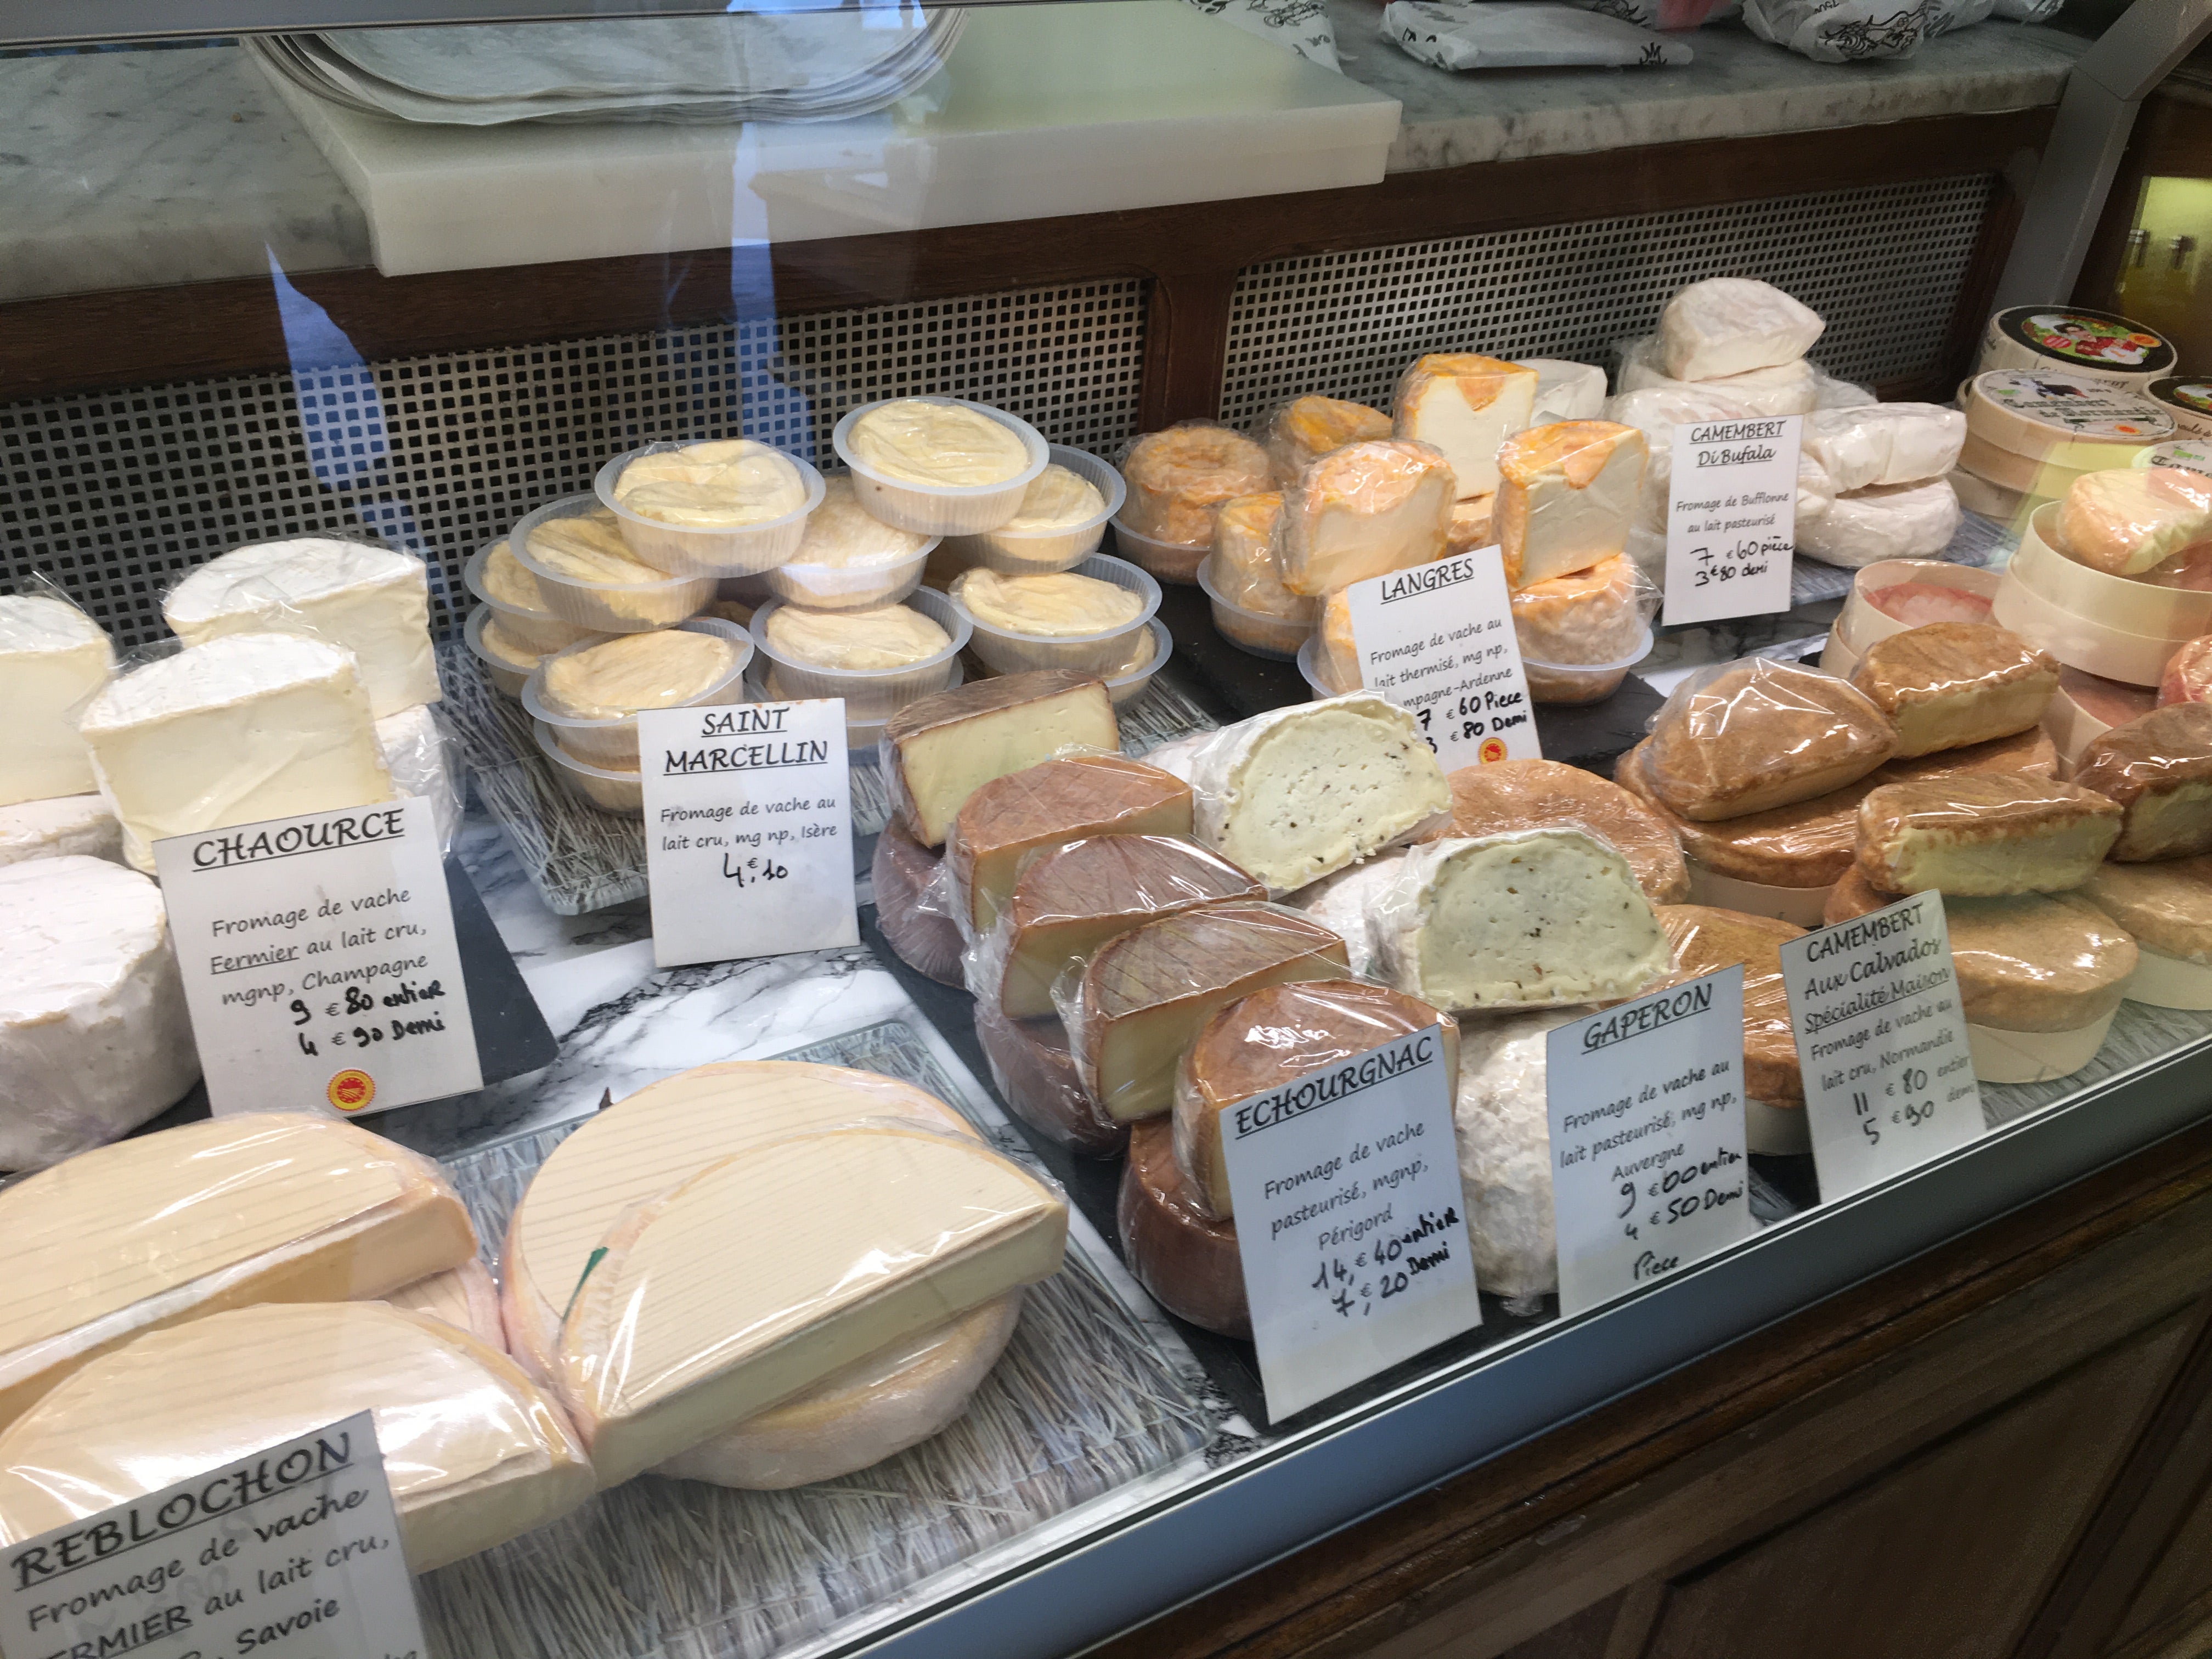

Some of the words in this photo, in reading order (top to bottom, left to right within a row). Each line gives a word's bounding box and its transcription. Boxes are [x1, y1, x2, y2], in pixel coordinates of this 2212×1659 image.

[1690, 420, 1787, 442] CAMEMBERT
[1677, 500, 1720, 512] Fromage
[1725, 496, 1737, 507] de
[1741, 493, 1789, 506] Bufflonne
[1688, 524, 1700, 533] au
[1705, 520, 1720, 532] lait
[1724, 514, 1776, 534] pasteurisé
[1381, 558, 1474, 601] LANGRES
[1371, 641, 1425, 665] Fromage
[1430, 633, 1444, 648] de
[1448, 623, 1483, 641] vache
[1487, 619, 1502, 630] au
[1400, 655, 1459, 683] thermisé,
[1463, 652, 1482, 666] mg
[1487, 644, 1508, 659] np,
[1403, 668, 1513, 708] mpagne-Ardenne
[702, 707, 790, 736] SAINT
[1492, 710, 1527, 732] Demi
[665, 741, 827, 772] MARCELLIN
[661, 808, 733, 822] Fromage
[740, 801, 759, 815] de
[765, 797, 810, 814] vache
[817, 798, 836, 809] au
[194, 809, 404, 868] CHAOURCE
[662, 836, 689, 850] lait
[696, 837, 729, 848] cru,
[736, 832, 761, 847] mg
[768, 830, 795, 845] np,
[802, 823, 837, 838] Isère
[212, 909, 309, 936] Fromage
[318, 899, 343, 917] de
[351, 888, 411, 911] vache
[1807, 902, 1924, 962] CAMEMBERT
[211, 945, 299, 974] Fermier
[307, 940, 332, 954] au
[342, 928, 376, 948] lait
[385, 923, 426, 939] cru,
[1805, 971, 1849, 1000] Aux
[1849, 937, 1941, 983] Calvados
[222, 982, 294, 1006] mgnp,
[302, 955, 428, 991] Champagne
[1805, 986, 1890, 1034] Spécialité
[1891, 967, 1951, 998] Maison
[1583, 983, 1712, 1050] GAPERON
[1810, 1026, 1870, 1062] Fromage
[1875, 1019, 1891, 1035] de
[1896, 1005, 1933, 1030] vache
[1936, 998, 1953, 1013] au
[1821, 1073, 1844, 1092] lait
[1849, 1062, 1876, 1081] cru,
[1880, 1028, 1954, 1069] Normandie
[1235, 1037, 1432, 1136] ECHOURGNAC
[1564, 1096, 1632, 1133] Fromage
[1639, 1085, 1657, 1104] de
[1662, 1065, 1706, 1094] vache
[1711, 1059, 1730, 1078] au
[1560, 1145, 1587, 1168] lait
[1592, 1110, 1675, 1162] pasteurisé,
[1681, 1103, 1705, 1122] mg
[1711, 1091, 1736, 1111] np,
[1264, 1156, 1343, 1200] Fromage
[1349, 1143, 1370, 1165] de
[1376, 1122, 1424, 1152] vache
[1611, 1142, 1685, 1182] Auvergne
[1271, 1182, 1366, 1240] pasteurisé,
[1373, 1158, 1428, 1191] mgnp,
[1319, 1203, 1392, 1250] Périgord
[10, 1432, 350, 1587] REBLOCHON
[27, 1558, 185, 1632] Fromage
[199, 1537, 240, 1566] de
[253, 1488, 369, 1543] vache
[46, 1604, 191, 1659] RMIER
[204, 1589, 244, 1616] au
[258, 1555, 313, 1594] lait
[324, 1536, 390, 1567] cru,
[236, 1597, 341, 1655] Savoie
